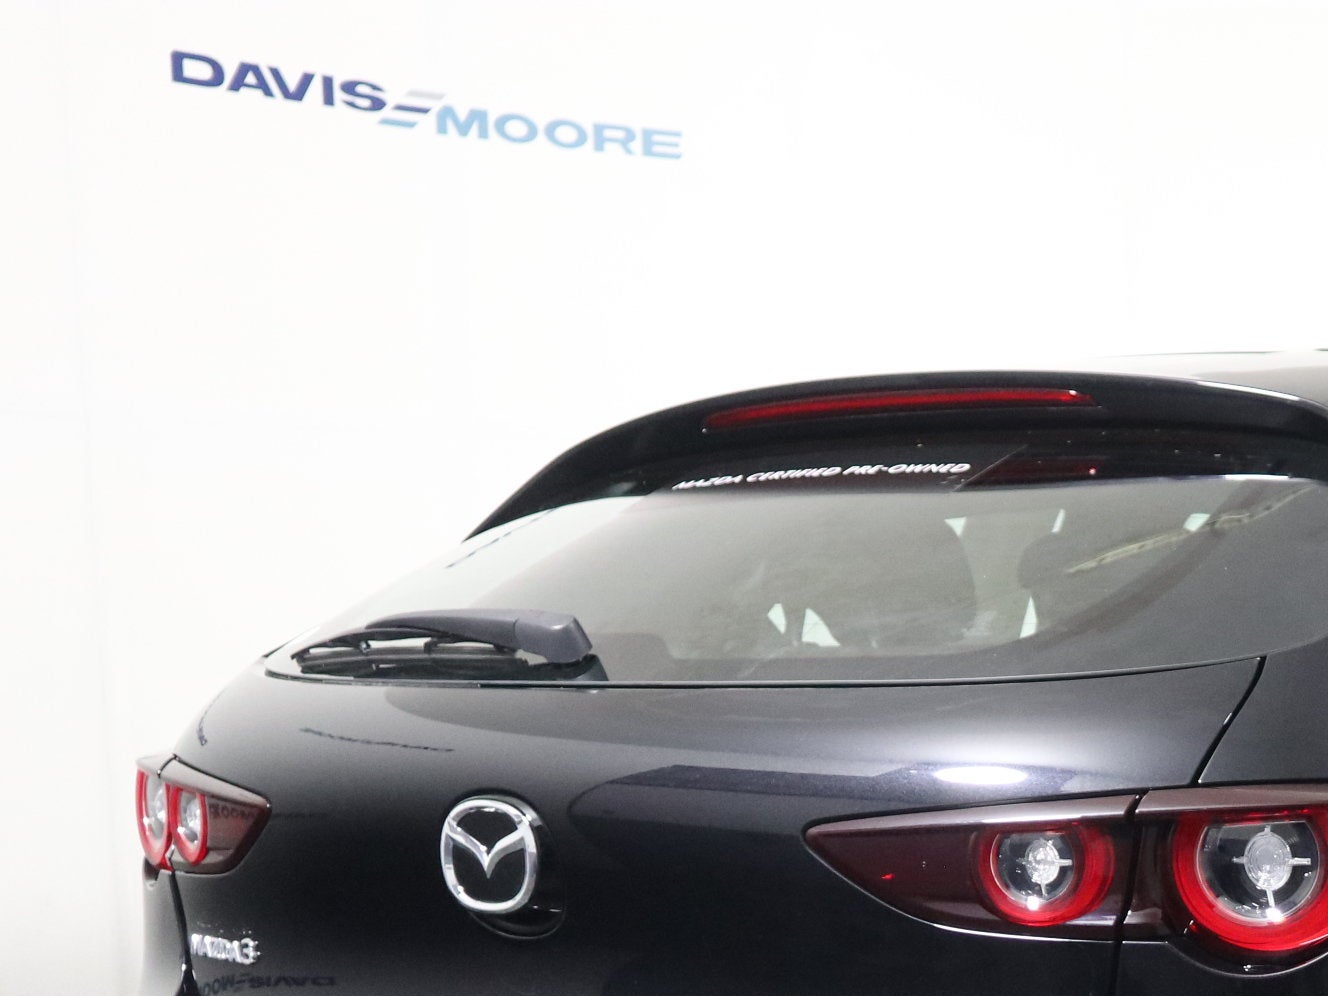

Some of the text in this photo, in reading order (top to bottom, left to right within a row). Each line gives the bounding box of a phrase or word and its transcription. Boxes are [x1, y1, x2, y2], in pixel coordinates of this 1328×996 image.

[170, 50, 682, 160] DAVIS MOORE
[672, 463, 972, 491] MAZDA CERTIFIED PRE-OWNED
